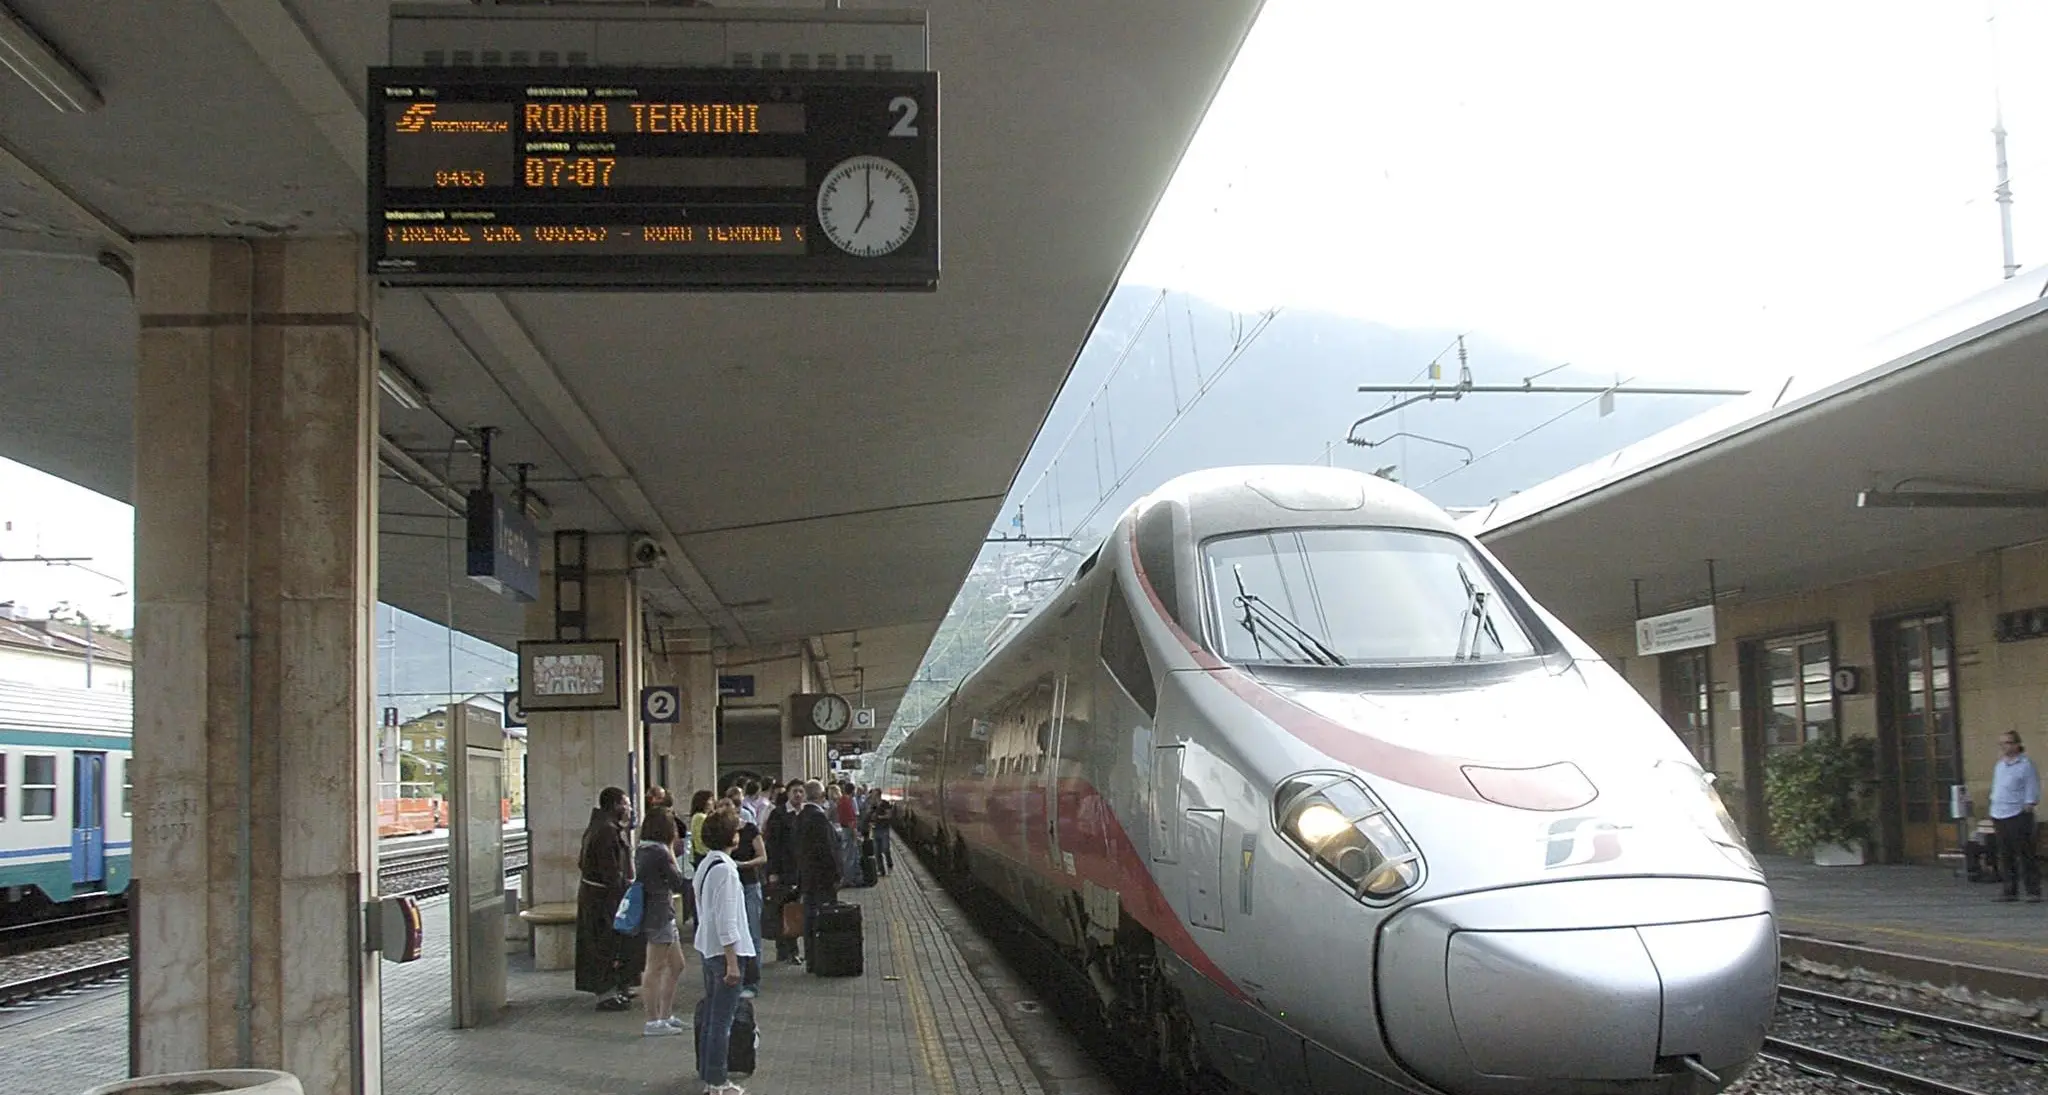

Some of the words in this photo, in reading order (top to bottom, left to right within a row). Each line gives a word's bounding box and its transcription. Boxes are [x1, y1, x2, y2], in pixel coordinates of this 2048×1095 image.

[525, 104, 608, 133] ROMA
[630, 104, 761, 133] TERMINI
[888, 97, 919, 137] 2
[525, 158, 616, 187] 07:07
[654, 696, 668, 714] 2
[857, 711, 869, 725] C
